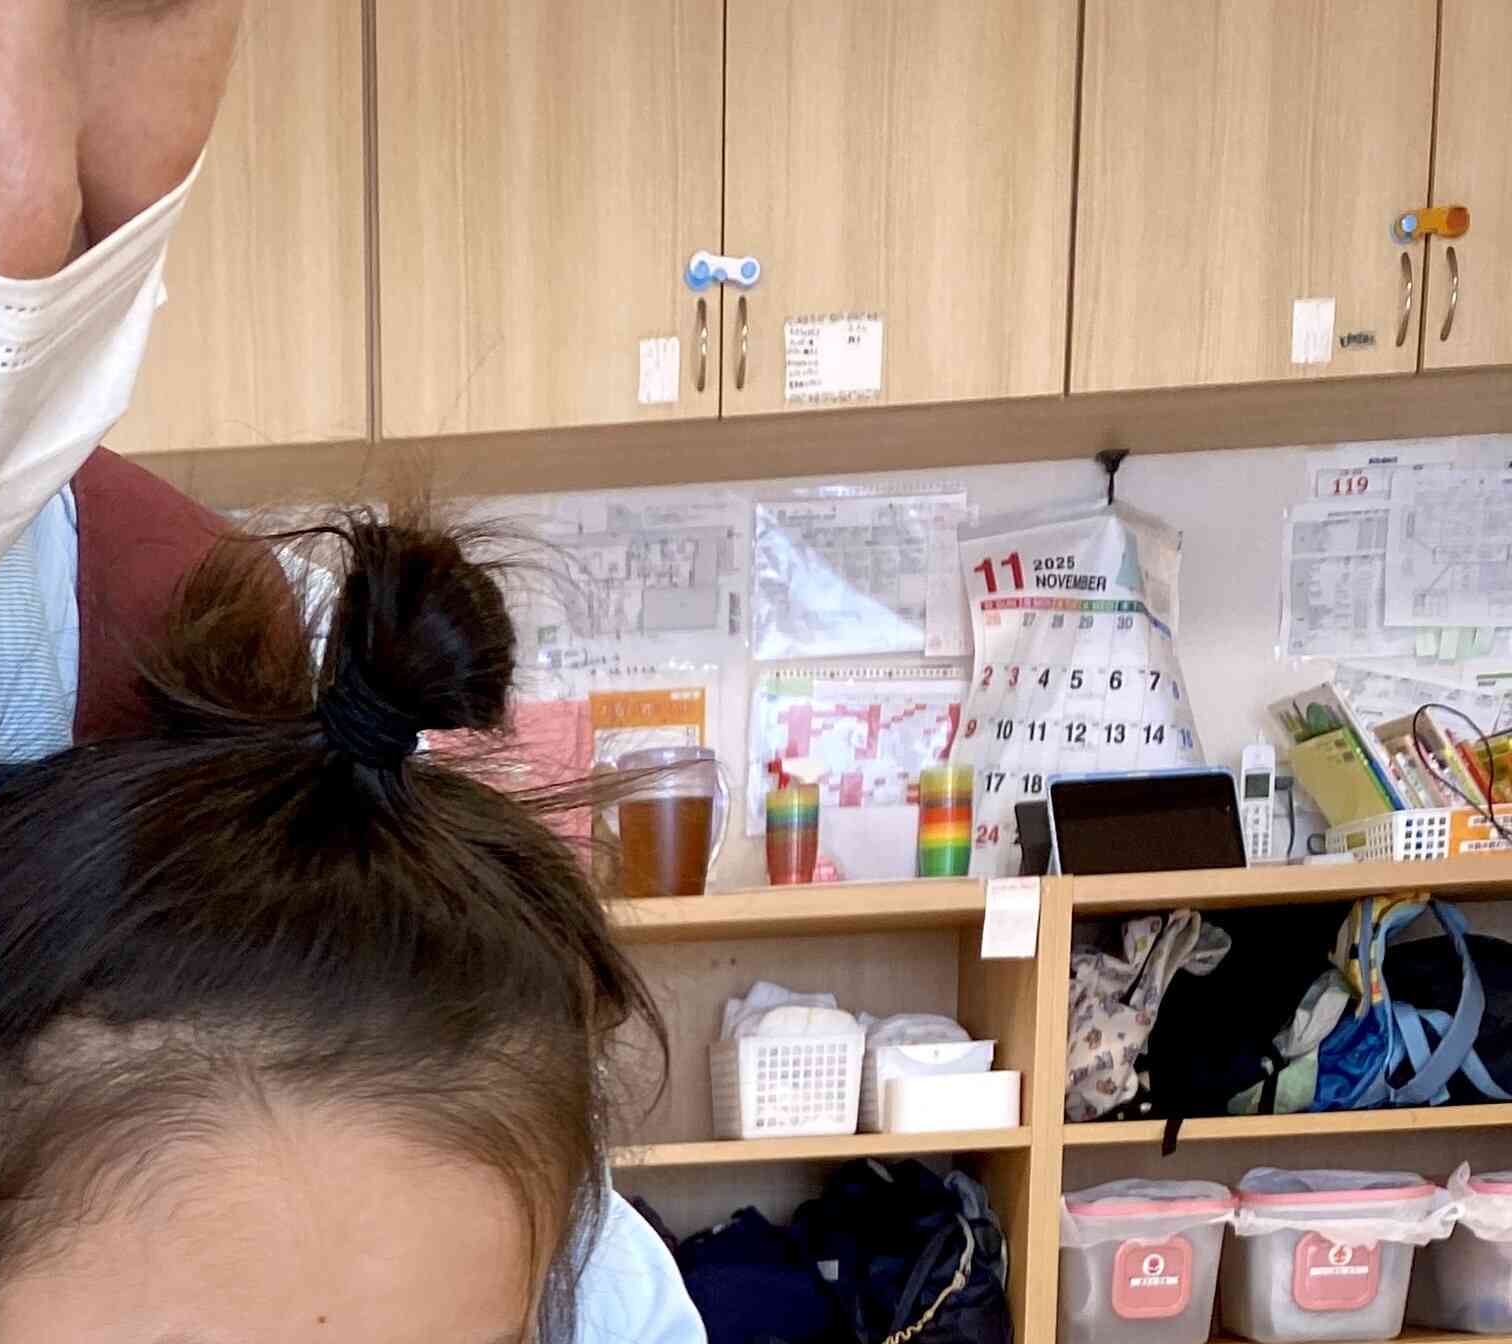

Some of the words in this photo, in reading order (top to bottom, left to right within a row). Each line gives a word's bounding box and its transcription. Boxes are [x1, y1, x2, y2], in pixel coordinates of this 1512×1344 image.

[1333, 476, 1369, 497] 119
[973, 551, 1025, 593] 11
[1033, 555, 1076, 571] 2025
[1035, 573, 1108, 592] NOVEMBER
[982, 666, 993, 687] 2
[1008, 666, 1020, 688] 3
[1038, 668, 1050, 688] 4
[1070, 669, 1084, 690] 5
[1109, 670, 1123, 690] 6
[1149, 671, 1161, 691] 7
[965, 720, 977, 737] 9
[996, 720, 1013, 740] 10
[1028, 721, 1047, 741] 11
[1065, 721, 1087, 743] 12
[1104, 723, 1126, 744] 13
[1143, 723, 1165, 745] 14
[985, 772, 1006, 793] 17
[1022, 773, 1043, 794] 18
[976, 825, 1000, 845] 24
